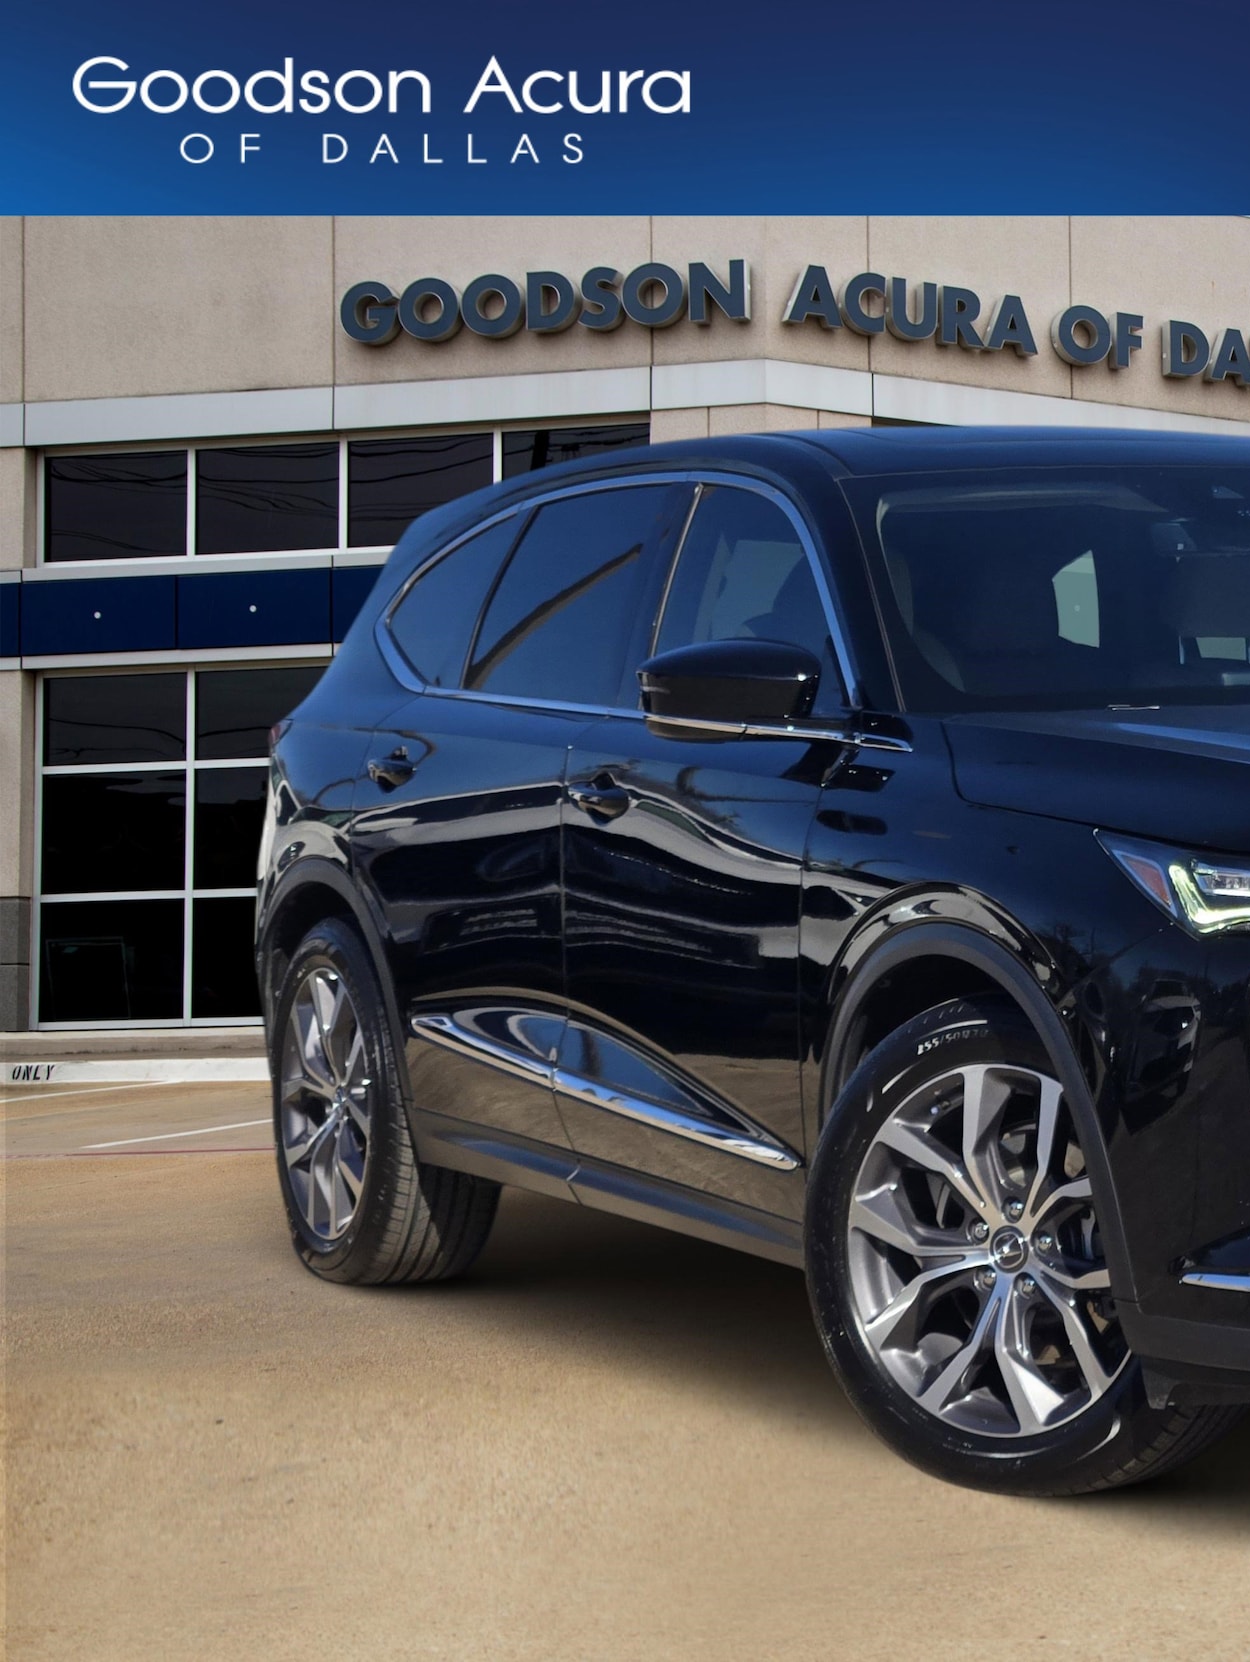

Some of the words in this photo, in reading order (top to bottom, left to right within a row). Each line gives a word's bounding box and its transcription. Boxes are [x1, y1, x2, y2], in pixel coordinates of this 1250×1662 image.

[340, 259, 750, 344] GOODSON
[782, 264, 1038, 357] ACURA
[1051, 304, 1143, 369] OF
[12, 1064, 55, 1080] ONLY
